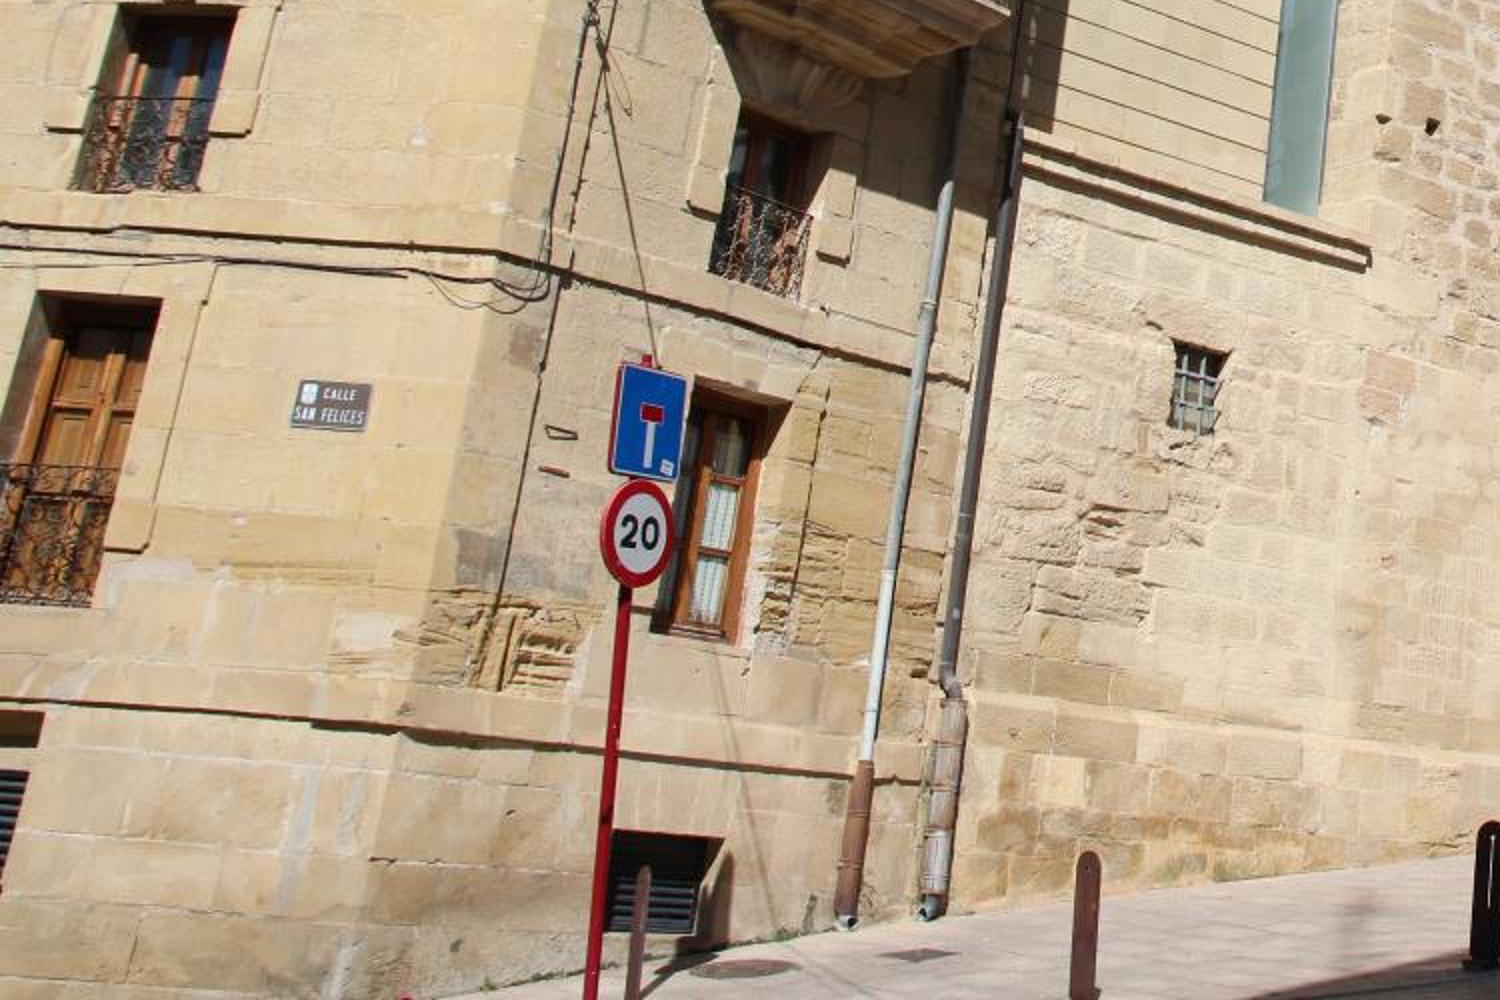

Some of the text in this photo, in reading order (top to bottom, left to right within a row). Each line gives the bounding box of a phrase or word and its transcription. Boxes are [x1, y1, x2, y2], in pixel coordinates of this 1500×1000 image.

[323, 387, 358, 401] CALLE
[294, 405, 316, 421] SAN
[620, 513, 660, 551] 20
